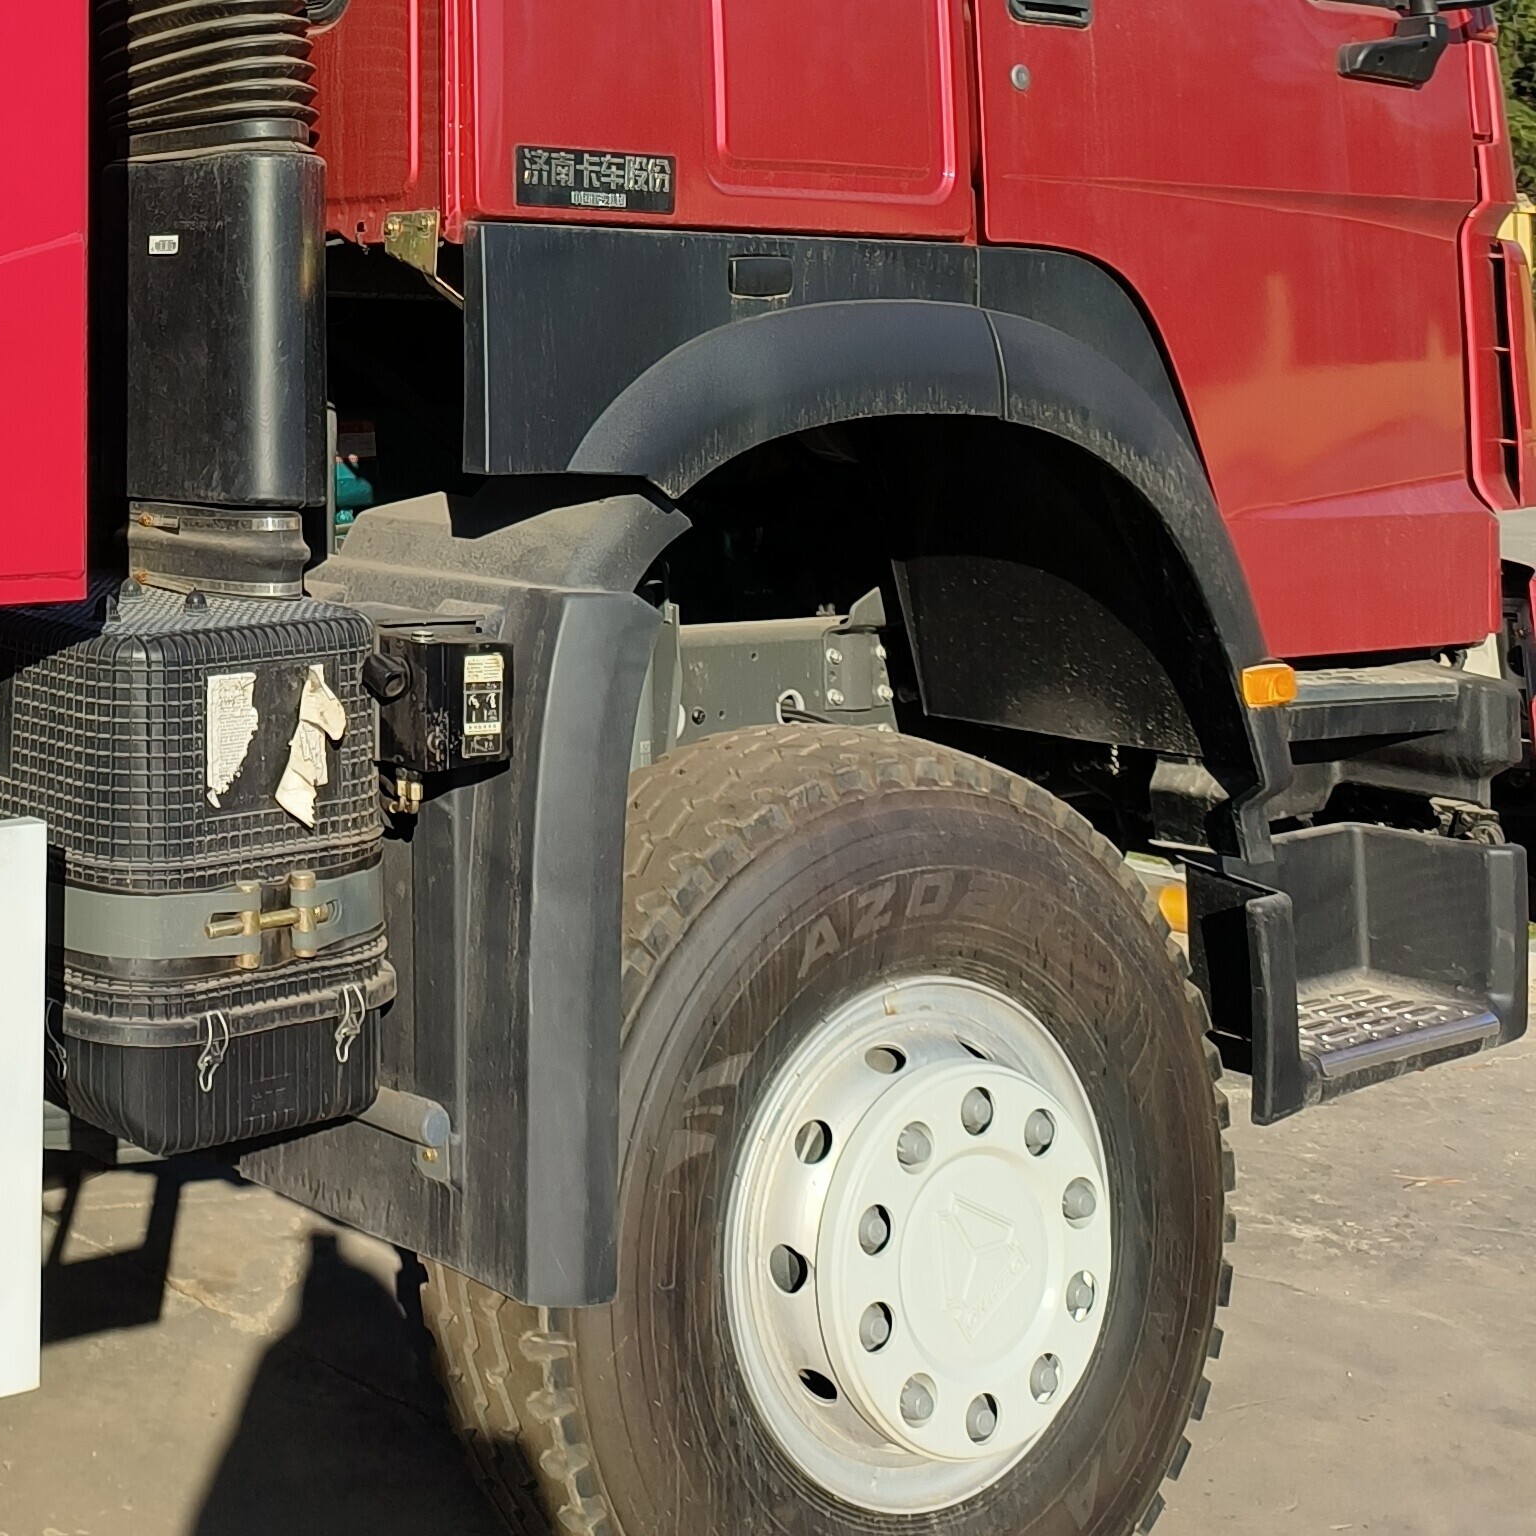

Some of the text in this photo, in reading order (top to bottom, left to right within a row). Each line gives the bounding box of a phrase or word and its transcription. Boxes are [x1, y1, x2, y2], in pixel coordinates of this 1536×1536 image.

[523, 148, 671, 193] 济南卡车股份
